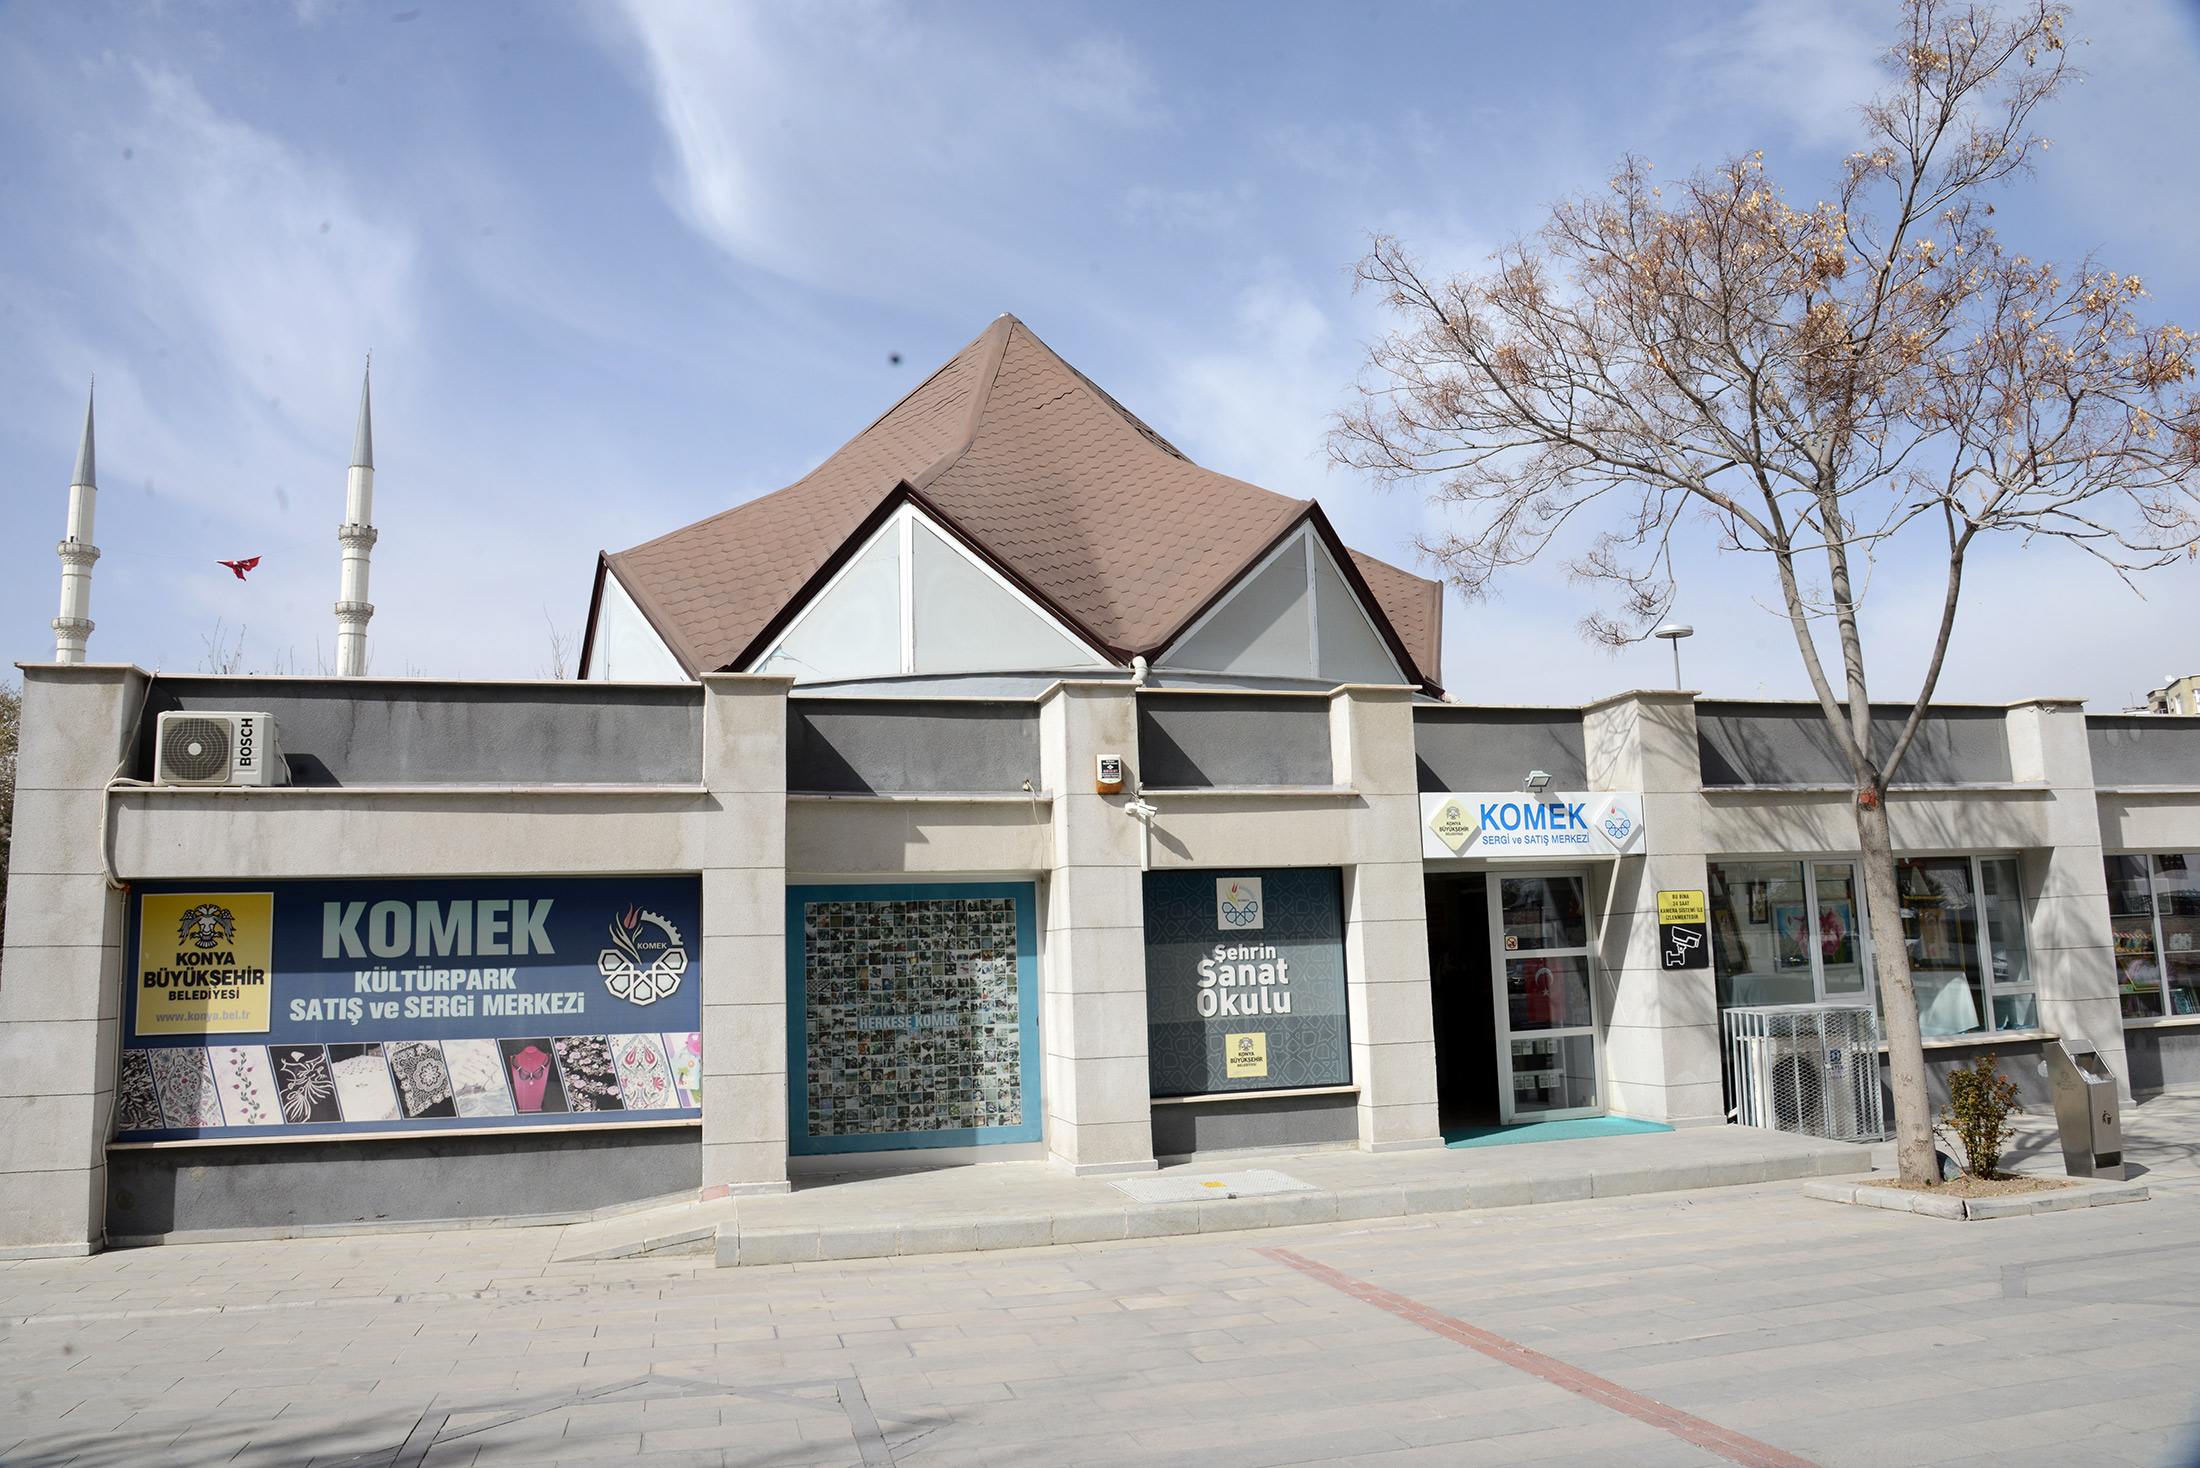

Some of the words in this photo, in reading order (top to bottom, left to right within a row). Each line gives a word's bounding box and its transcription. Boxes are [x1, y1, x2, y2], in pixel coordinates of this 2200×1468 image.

[239, 718, 254, 767] BOSCH
[1480, 803, 1589, 831] KOMEK
[1482, 834, 1511, 846] SERGİ
[1512, 836, 1522, 845] ve
[1524, 834, 1550, 847] SATIŞ
[1551, 832, 1590, 844] MERKEZİ
[322, 899, 555, 959] KOMEK
[637, 941, 668, 951] KOMEK
[1215, 943, 1277, 963] Şehrin
[176, 952, 235, 966] KONYA
[144, 966, 265, 988] BÜYÜKŞEHİR
[354, 966, 517, 993] KÜLTÜRPARK
[1197, 958, 1289, 987] Sanat
[168, 987, 240, 1001] BELEDİYESİ
[1197, 987, 1291, 1017] Okulu
[156, 1010, 251, 1023] www.konya.bel.tr
[289, 997, 363, 1026] SATIŞ
[370, 1000, 399, 1019] ve
[860, 1016, 912, 1029] HERKESE
[915, 1014, 958, 1027] KOMEK
